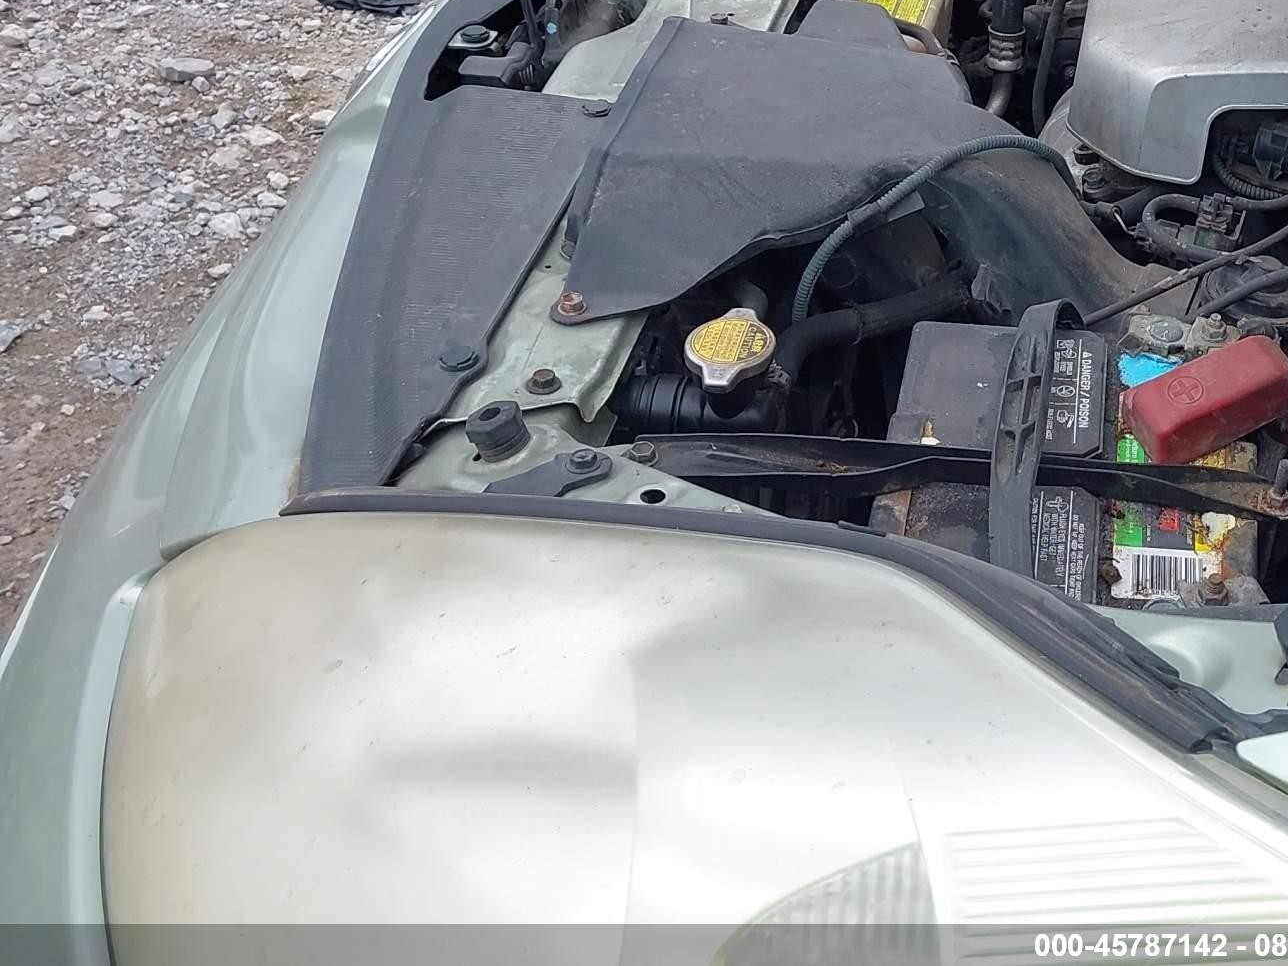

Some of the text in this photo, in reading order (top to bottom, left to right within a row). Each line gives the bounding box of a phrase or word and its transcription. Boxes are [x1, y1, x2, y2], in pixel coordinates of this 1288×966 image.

[738, 326, 757, 358] CAUTION
[1081, 360, 1092, 392] DANGER
[1079, 399, 1090, 428] POISON
